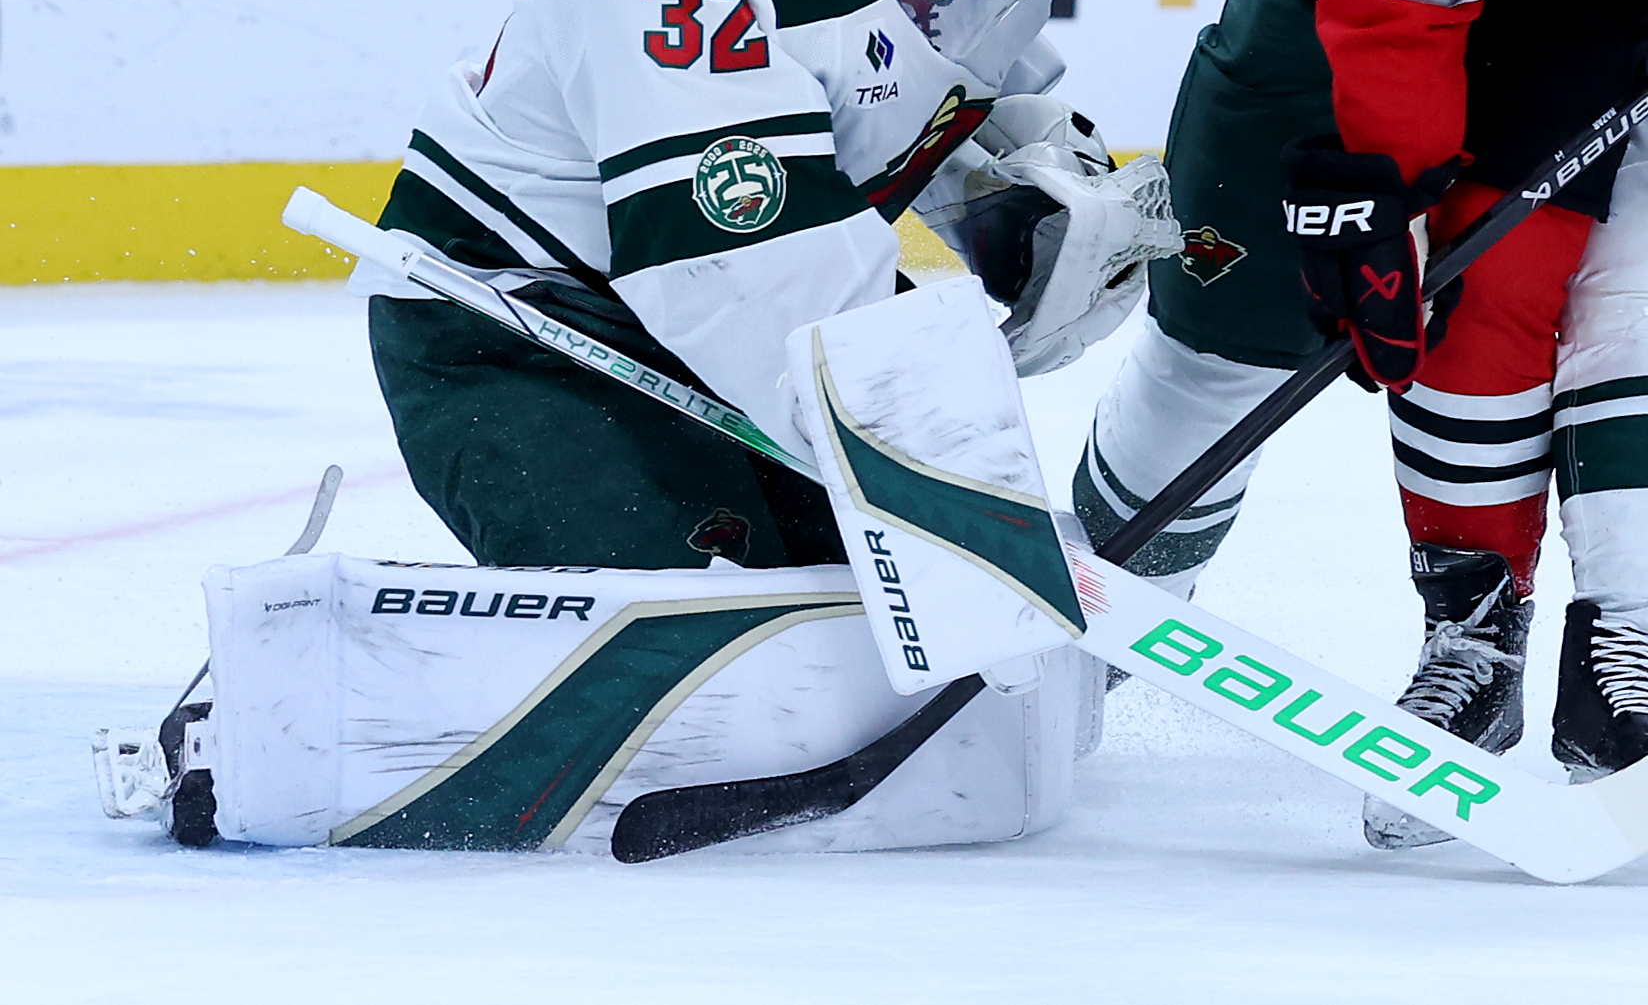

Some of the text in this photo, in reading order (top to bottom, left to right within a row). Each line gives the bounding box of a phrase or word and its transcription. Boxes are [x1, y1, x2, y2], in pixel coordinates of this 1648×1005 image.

[856, 82, 899, 104] TRIA
[700, 141, 767, 175] 2000 2025
[1282, 199, 1375, 237] UER
[1412, 549, 1430, 573] 91
[371, 587, 596, 621] BAUER
[863, 530, 931, 672] BAUER
[1129, 618, 1501, 822] BAUER
